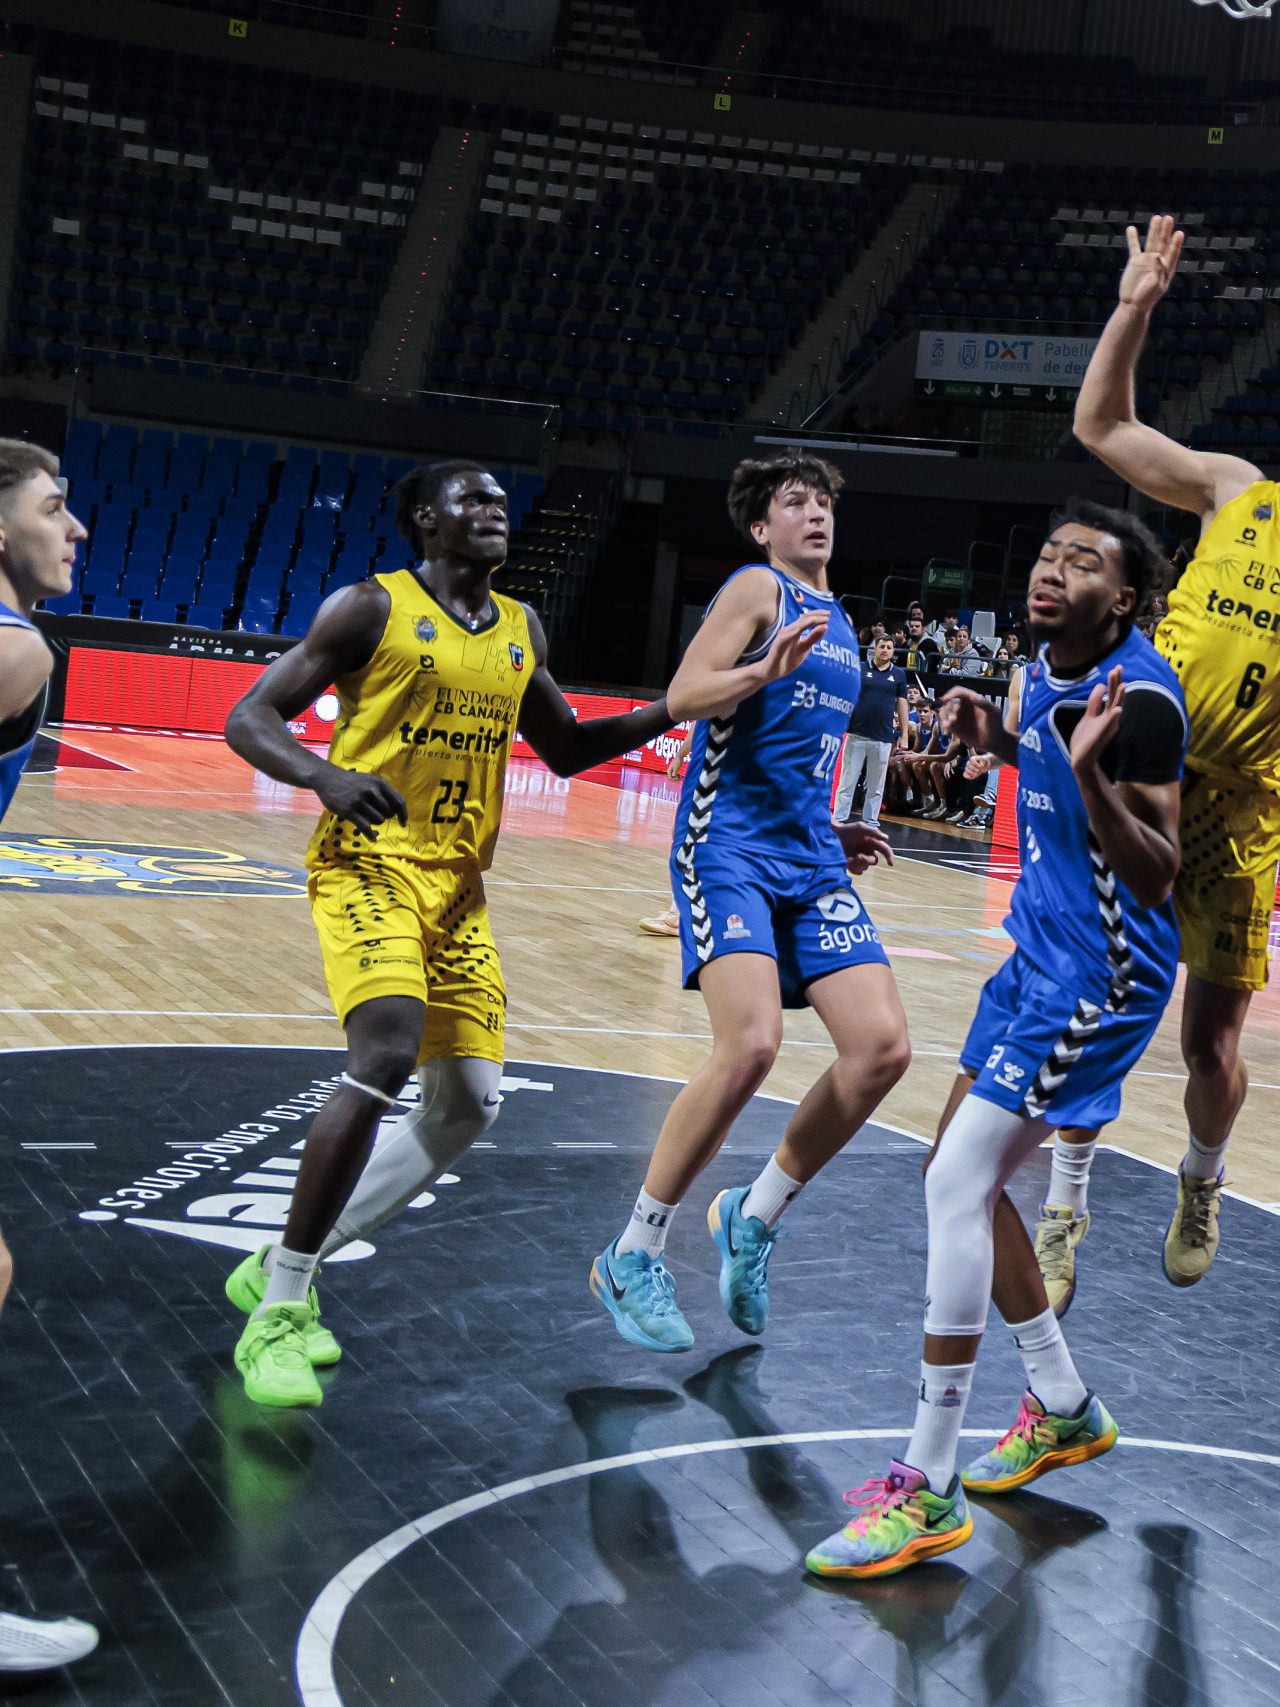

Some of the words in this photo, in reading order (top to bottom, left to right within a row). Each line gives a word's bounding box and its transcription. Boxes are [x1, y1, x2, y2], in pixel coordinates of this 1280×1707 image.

[985, 340, 1033, 360] DXT
[1045, 342, 1096, 357] Pabell
[985, 361, 1031, 373] TENERIFE
[1043, 360, 1060, 374] de
[1243, 574, 1265, 590] CB
[173, 636, 222, 645] NAVIERA
[1234, 661, 1267, 710] 6
[434, 701, 454, 714] CB
[431, 779, 468, 824] 23
[818, 923, 881, 952] ágora
[98, 1121, 281, 1210] emociones
